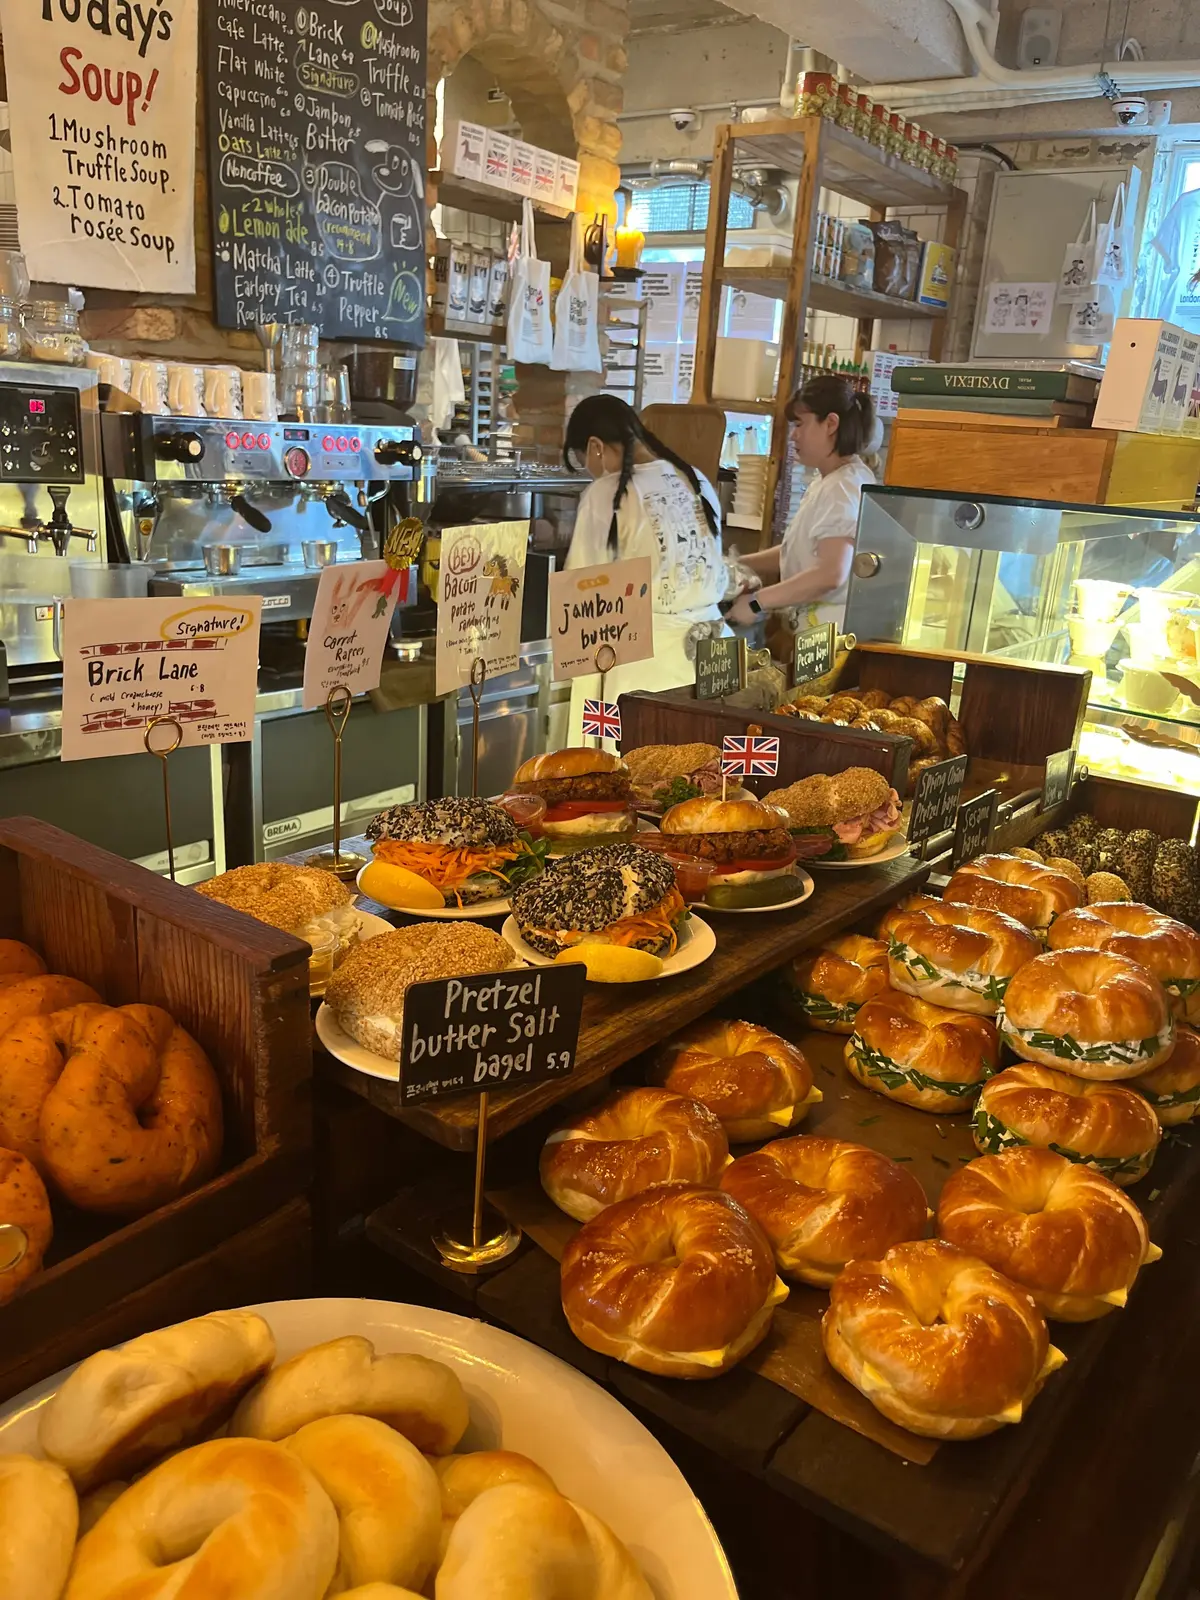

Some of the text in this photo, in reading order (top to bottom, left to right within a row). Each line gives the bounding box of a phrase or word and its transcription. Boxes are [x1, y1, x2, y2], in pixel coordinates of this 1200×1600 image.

[218, 16, 245, 40] Cafe
[254, 23, 285, 54] Latte
[309, 12, 343, 45] Brick
[218, 45, 247, 75] Flat
[309, 42, 339, 69] Lane
[363, 58, 409, 93] Truffle
[219, 108, 255, 132] Vanilla
[306, 96, 351, 128] Jambon
[218, 134, 252, 153] Oats
[306, 122, 356, 153] Butter
[62, 149, 127, 182] Truffle
[227, 159, 287, 188] Noncoffee
[321, 167, 358, 196] Double
[233, 209, 280, 239] Lemon
[234, 243, 281, 275] Matcha
[287, 254, 314, 282] Latte
[235, 274, 281, 306] Earlgrey
[285, 285, 307, 307] Tea
[341, 271, 384, 296] Truffle
[340, 296, 379, 328] Pepper
[944, 375, 1010, 390] DYSLEXIA
[388, 528, 422, 557] NEW
[453, 546, 475, 569] BEST
[444, 572, 477, 602] Bacon
[176, 615, 244, 637] Signature!
[559, 593, 623, 634] jambon
[323, 629, 357, 649] Carrot
[581, 622, 628, 649] butter
[711, 640, 727, 658] Dark
[88, 657, 198, 687] Brick Lane
[267, 821, 297, 837] BREMA
[444, 974, 541, 1019] Pretzel
[409, 1023, 496, 1064] butter
[473, 1043, 571, 1082] bagel 5.9
